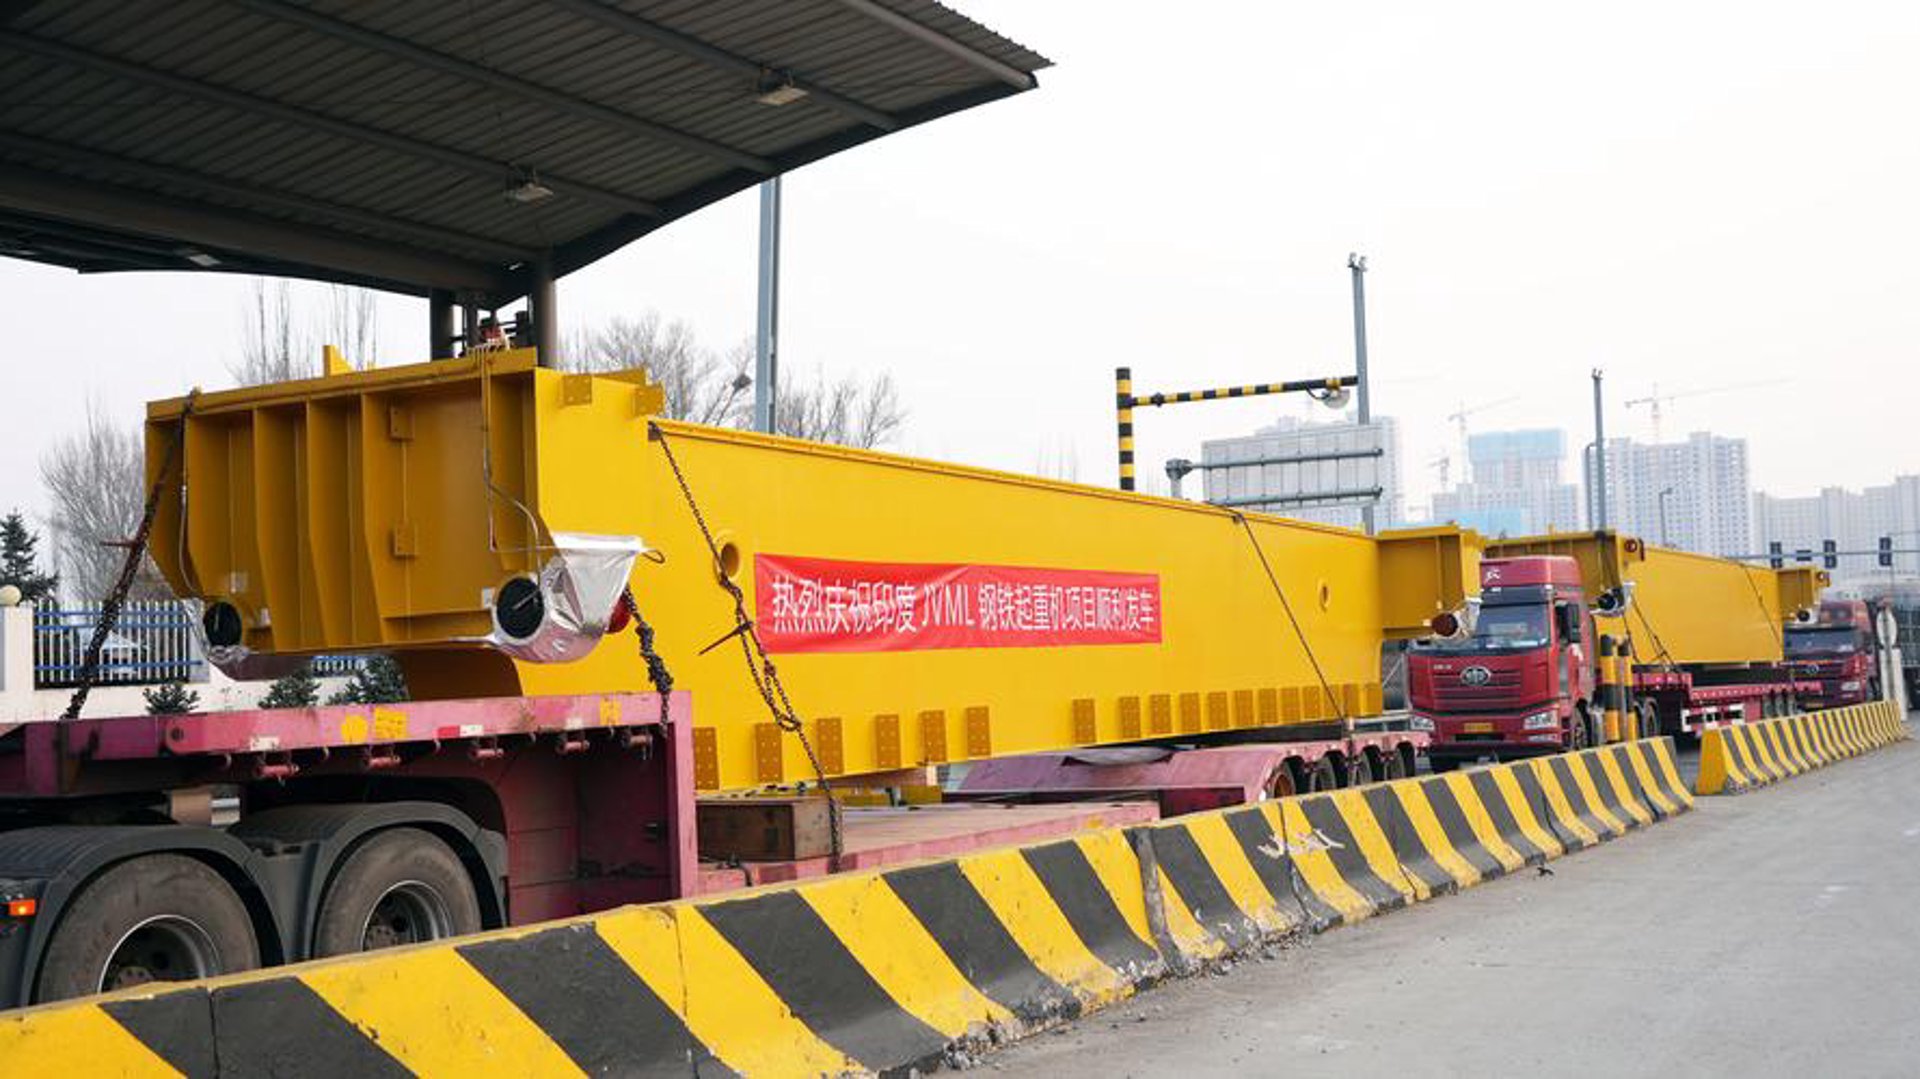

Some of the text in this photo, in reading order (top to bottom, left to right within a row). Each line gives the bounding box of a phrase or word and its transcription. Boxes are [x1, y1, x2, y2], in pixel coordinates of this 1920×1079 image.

[772, 575, 1154, 633] 热烈庆祝印度 JVML 钢铁起重机项目顺利发车
